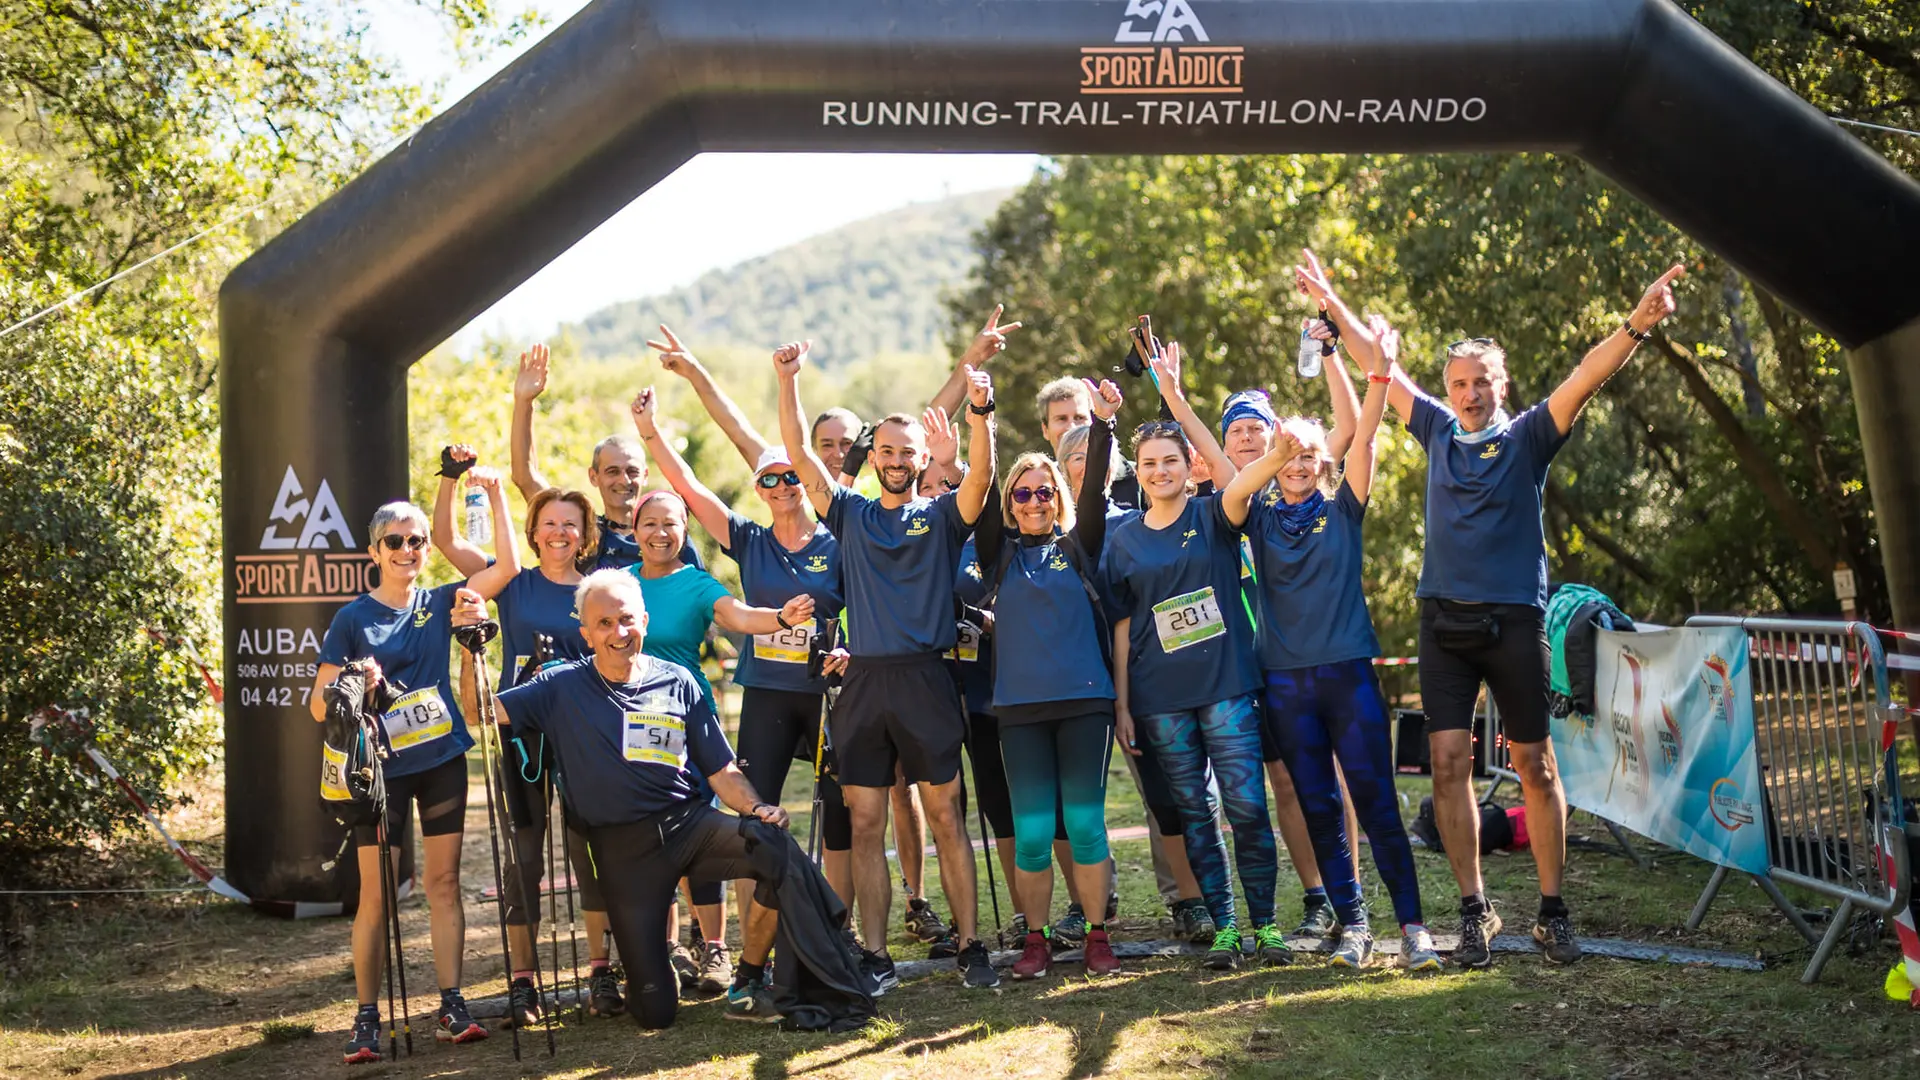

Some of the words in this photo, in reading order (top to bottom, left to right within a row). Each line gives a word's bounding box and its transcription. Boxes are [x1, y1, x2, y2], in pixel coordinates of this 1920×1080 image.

[821, 97, 1487, 127] RUNNING-TRAIL-TRIATHLON-RANDO
[1169, 603, 1210, 631] 201
[237, 663, 258, 678] 506
[260, 663, 280, 678] AV
[282, 662, 318, 678] DES
[241, 686, 262, 706] 04
[265, 686, 293, 706] 42
[403, 701, 443, 728] 109
[648, 727, 671, 748] 51
